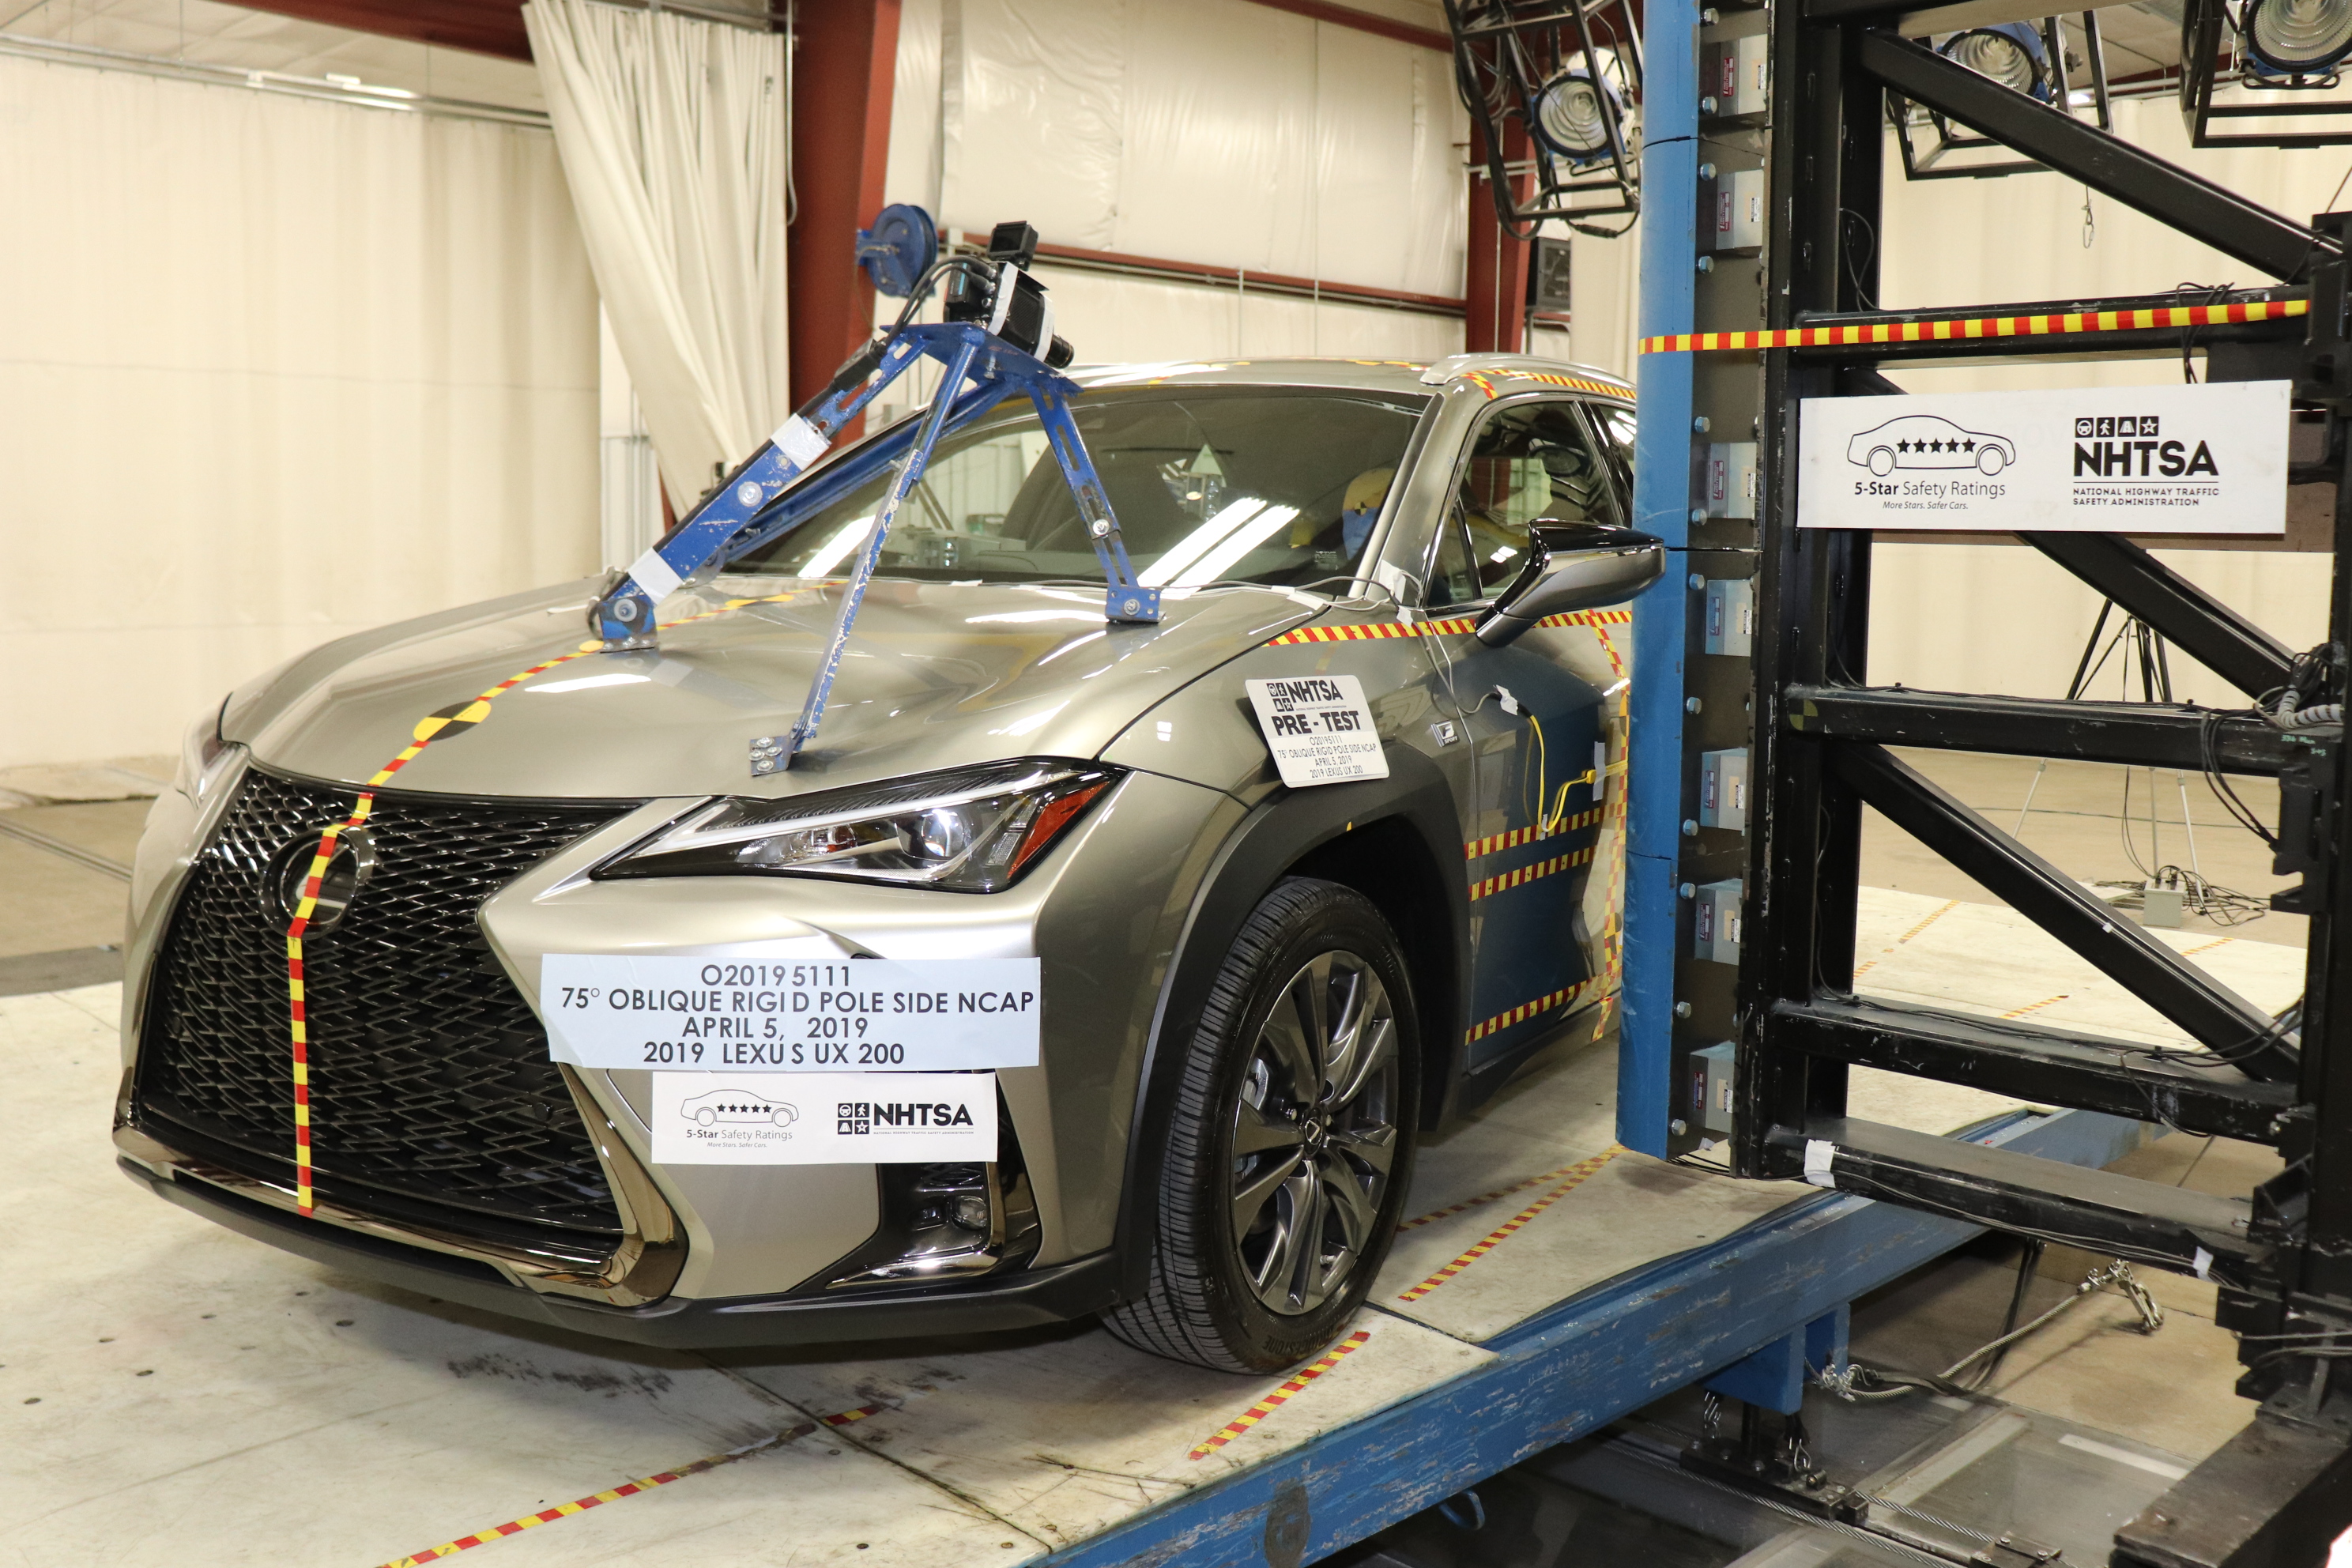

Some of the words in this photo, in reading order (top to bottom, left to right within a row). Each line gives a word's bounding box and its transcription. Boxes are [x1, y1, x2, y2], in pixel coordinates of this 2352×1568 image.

[2073, 440, 2219, 477] NHTSA
[1854, 481, 1898, 495] 5-Star
[1903, 481, 1947, 499] Safety
[1951, 481, 2006, 499] Ratings
[1285, 680, 1344, 703] NHTSA
[1271, 714, 1313, 736] PRE
[1319, 710, 1361, 732] TEST
[1288, 748, 1316, 758] OBLIQUE
[1316, 746, 1333, 756] RIGID
[1334, 744, 1349, 755] POLE
[1349, 744, 1362, 753] SIDE
[1362, 743, 1377, 752] NCAP
[1314, 757, 1332, 767] APRIL
[1332, 756, 1339, 766] 5,
[1339, 755, 1352, 765] 2019
[1310, 768, 1325, 778] 2019
[1325, 767, 1343, 777] LEXUS
[1343, 766, 1352, 775] UX
[1353, 765, 1363, 774] 200
[562, 987, 600, 1008] 75°
[609, 989, 722, 1012] OBLIQUE
[733, 991, 809, 1012] RIGID
[820, 992, 884, 1012] POLE
[893, 992, 948, 1013] SIDE
[958, 992, 1034, 1013] NCAP
[682, 1017, 754, 1038] APRIL
[763, 1017, 785, 1041] 5,
[807, 1017, 868, 1038] 2019
[643, 1042, 704, 1063] 2019
[723, 1043, 804, 1064] LEXUS
[815, 1043, 850, 1064] UX
[858, 1043, 905, 1064] 200
[873, 1103, 974, 1126] NHTSA
[686, 1129, 719, 1139] 5-Star
[721, 1129, 752, 1141] Safety
[756, 1130, 793, 1141] Ratings
